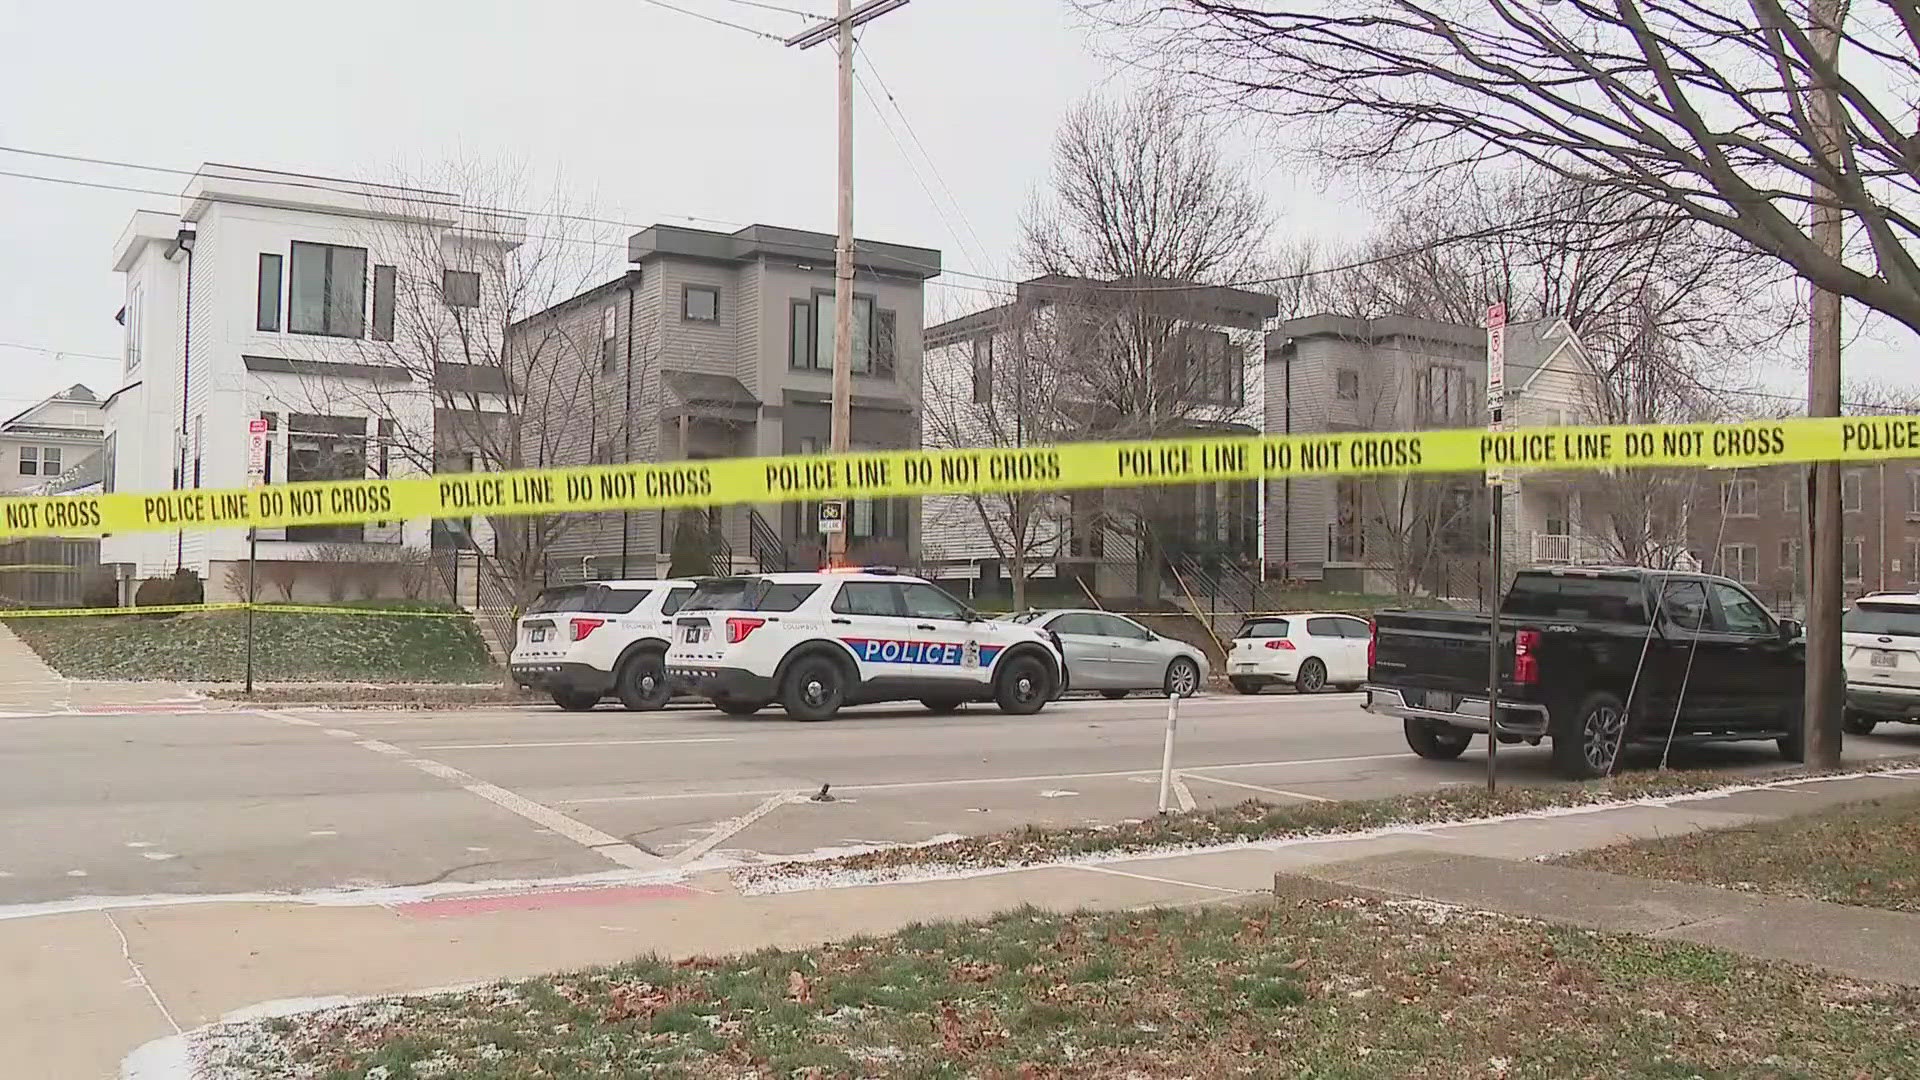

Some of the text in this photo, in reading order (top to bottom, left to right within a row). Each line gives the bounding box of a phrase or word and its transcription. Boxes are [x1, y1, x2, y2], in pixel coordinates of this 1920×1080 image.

[1481, 427, 1785, 463] POLICE LINE DO NOT CROSS
[1843, 421, 1919, 451] POLICE
[766, 451, 1060, 494] POLICE LINE DO NOT CROSS
[1118, 438, 1422, 478] POLICE LINE DO NOT CROSS
[145, 484, 391, 523] POLICE LINE DO NOT CROSS
[440, 466, 712, 508] POLICE LINE DO NOT CROSS
[7, 500, 101, 528] NOT CROSS
[865, 640, 957, 664] POLICE
